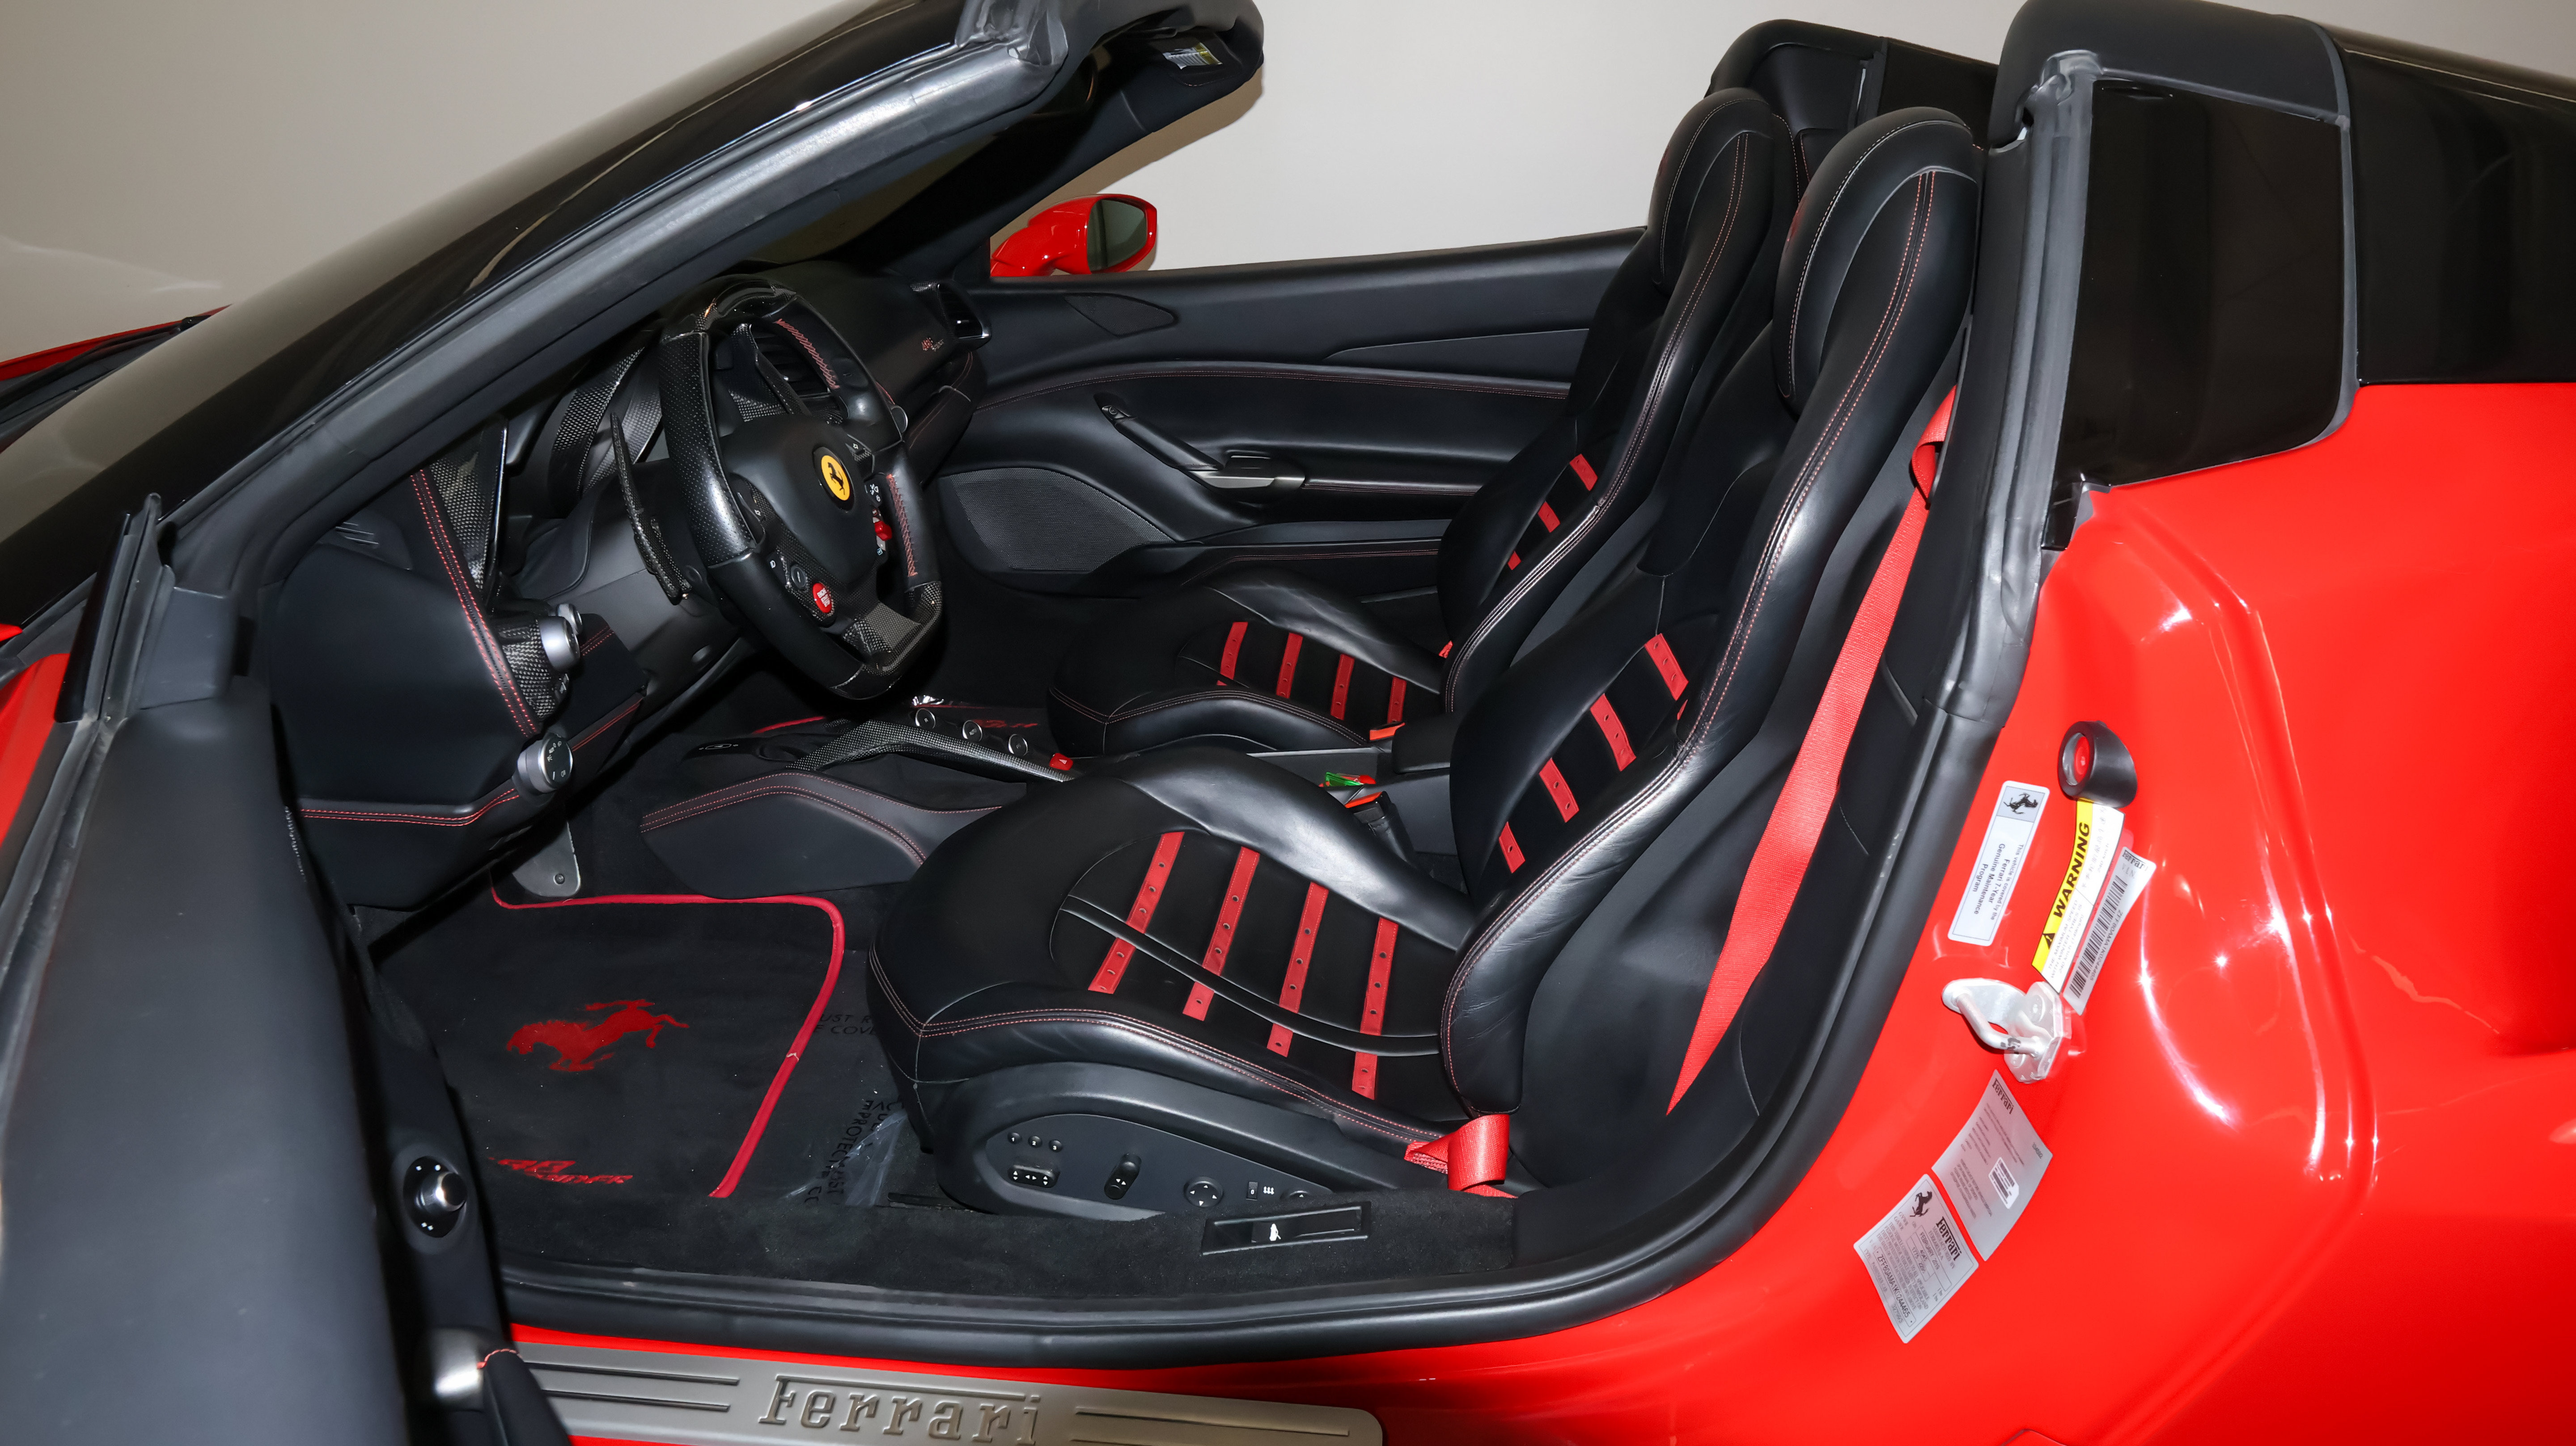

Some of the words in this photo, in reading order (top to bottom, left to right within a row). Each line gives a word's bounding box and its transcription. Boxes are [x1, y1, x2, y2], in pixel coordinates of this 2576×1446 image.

[1990, 843, 2005, 871] Genuine
[2015, 844, 2024, 855] This
[2122, 849, 2148, 871] Ferrari
[1972, 864, 1988, 892] Program
[1997, 859, 2010, 881] Ferrari
[2008, 857, 2018, 875] vehicle
[2053, 822, 2090, 917] WARNING
[1974, 874, 1995, 914] Maintenance
[1988, 882, 2001, 903] 7-Year
[1997, 883, 2008, 903] covered
[2053, 924, 2068, 955] MAXIMUM
[2067, 899, 2078, 922] SPEED
[2058, 934, 2070, 960] WINTER
[1992, 1078, 2014, 1115] Ferrari
[1919, 1232, 1934, 1256] FEBRUARY
[1932, 1258, 1940, 1270] 2019
[1936, 1216, 1962, 1261] Ferrari
[758, 1374, 1041, 1445] Ferrari
